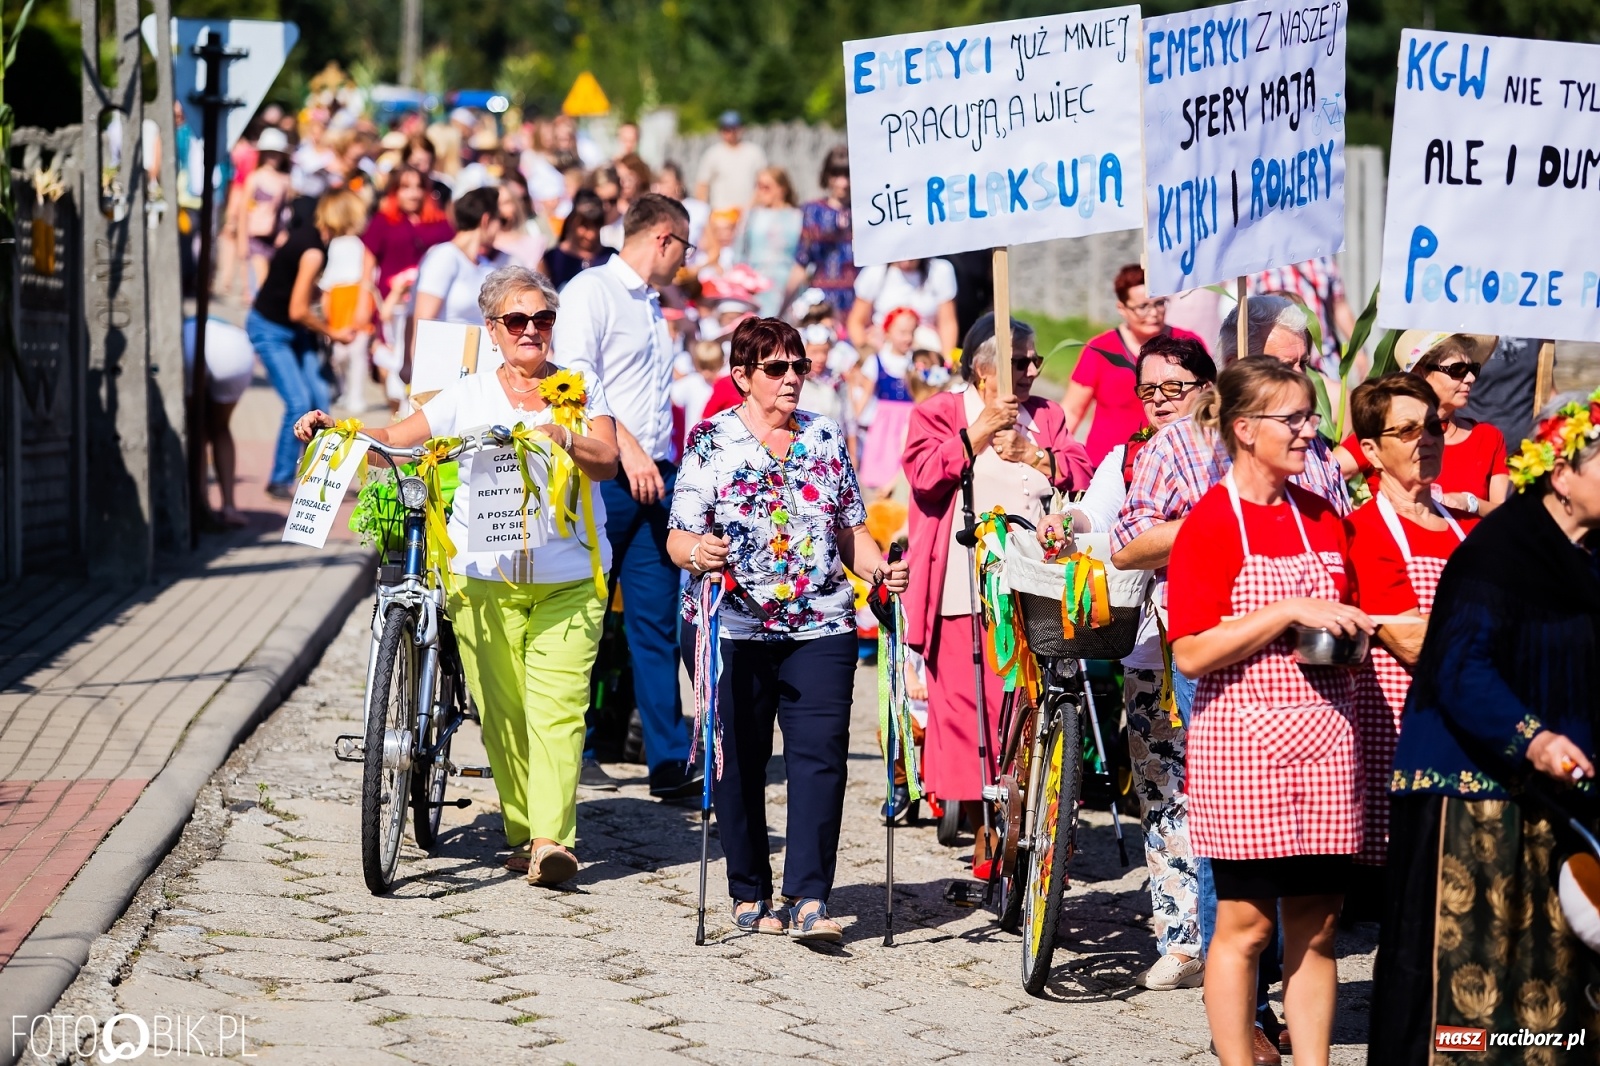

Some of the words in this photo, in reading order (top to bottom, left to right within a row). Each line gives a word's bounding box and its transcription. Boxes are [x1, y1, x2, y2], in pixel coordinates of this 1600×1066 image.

[853, 38, 992, 94] EMERYCI
[1010, 25, 1051, 82] JUŻ
[1064, 15, 1130, 63] MNIEJ
[1148, 17, 1248, 85] EMERYCI
[1254, 11, 1271, 53] Z
[1279, 1, 1342, 57] NASZEJ
[1406, 37, 1489, 100] KGW
[1504, 75, 1543, 106] NIE
[1034, 80, 1096, 125] WIĘC
[1180, 84, 1250, 151] SFERY
[1260, 66, 1317, 131] MAJĄ
[867, 183, 912, 227] SIĘ
[926, 152, 1123, 226] RELAKSUJĄ
[1424, 138, 1484, 186] ALE
[1506, 144, 1517, 186] I
[1158, 175, 1218, 276] KIJKI
[1230, 169, 1239, 228] I
[1250, 138, 1335, 221] ROWERY
[1405, 224, 1564, 305] POCHODZIE
[1580, 271, 1600, 308] P
[477, 512, 485, 520] A
[478, 488, 511, 497] RENTY
[513, 485, 541, 494] MO
[486, 532, 531, 543] CHCIAŁO
